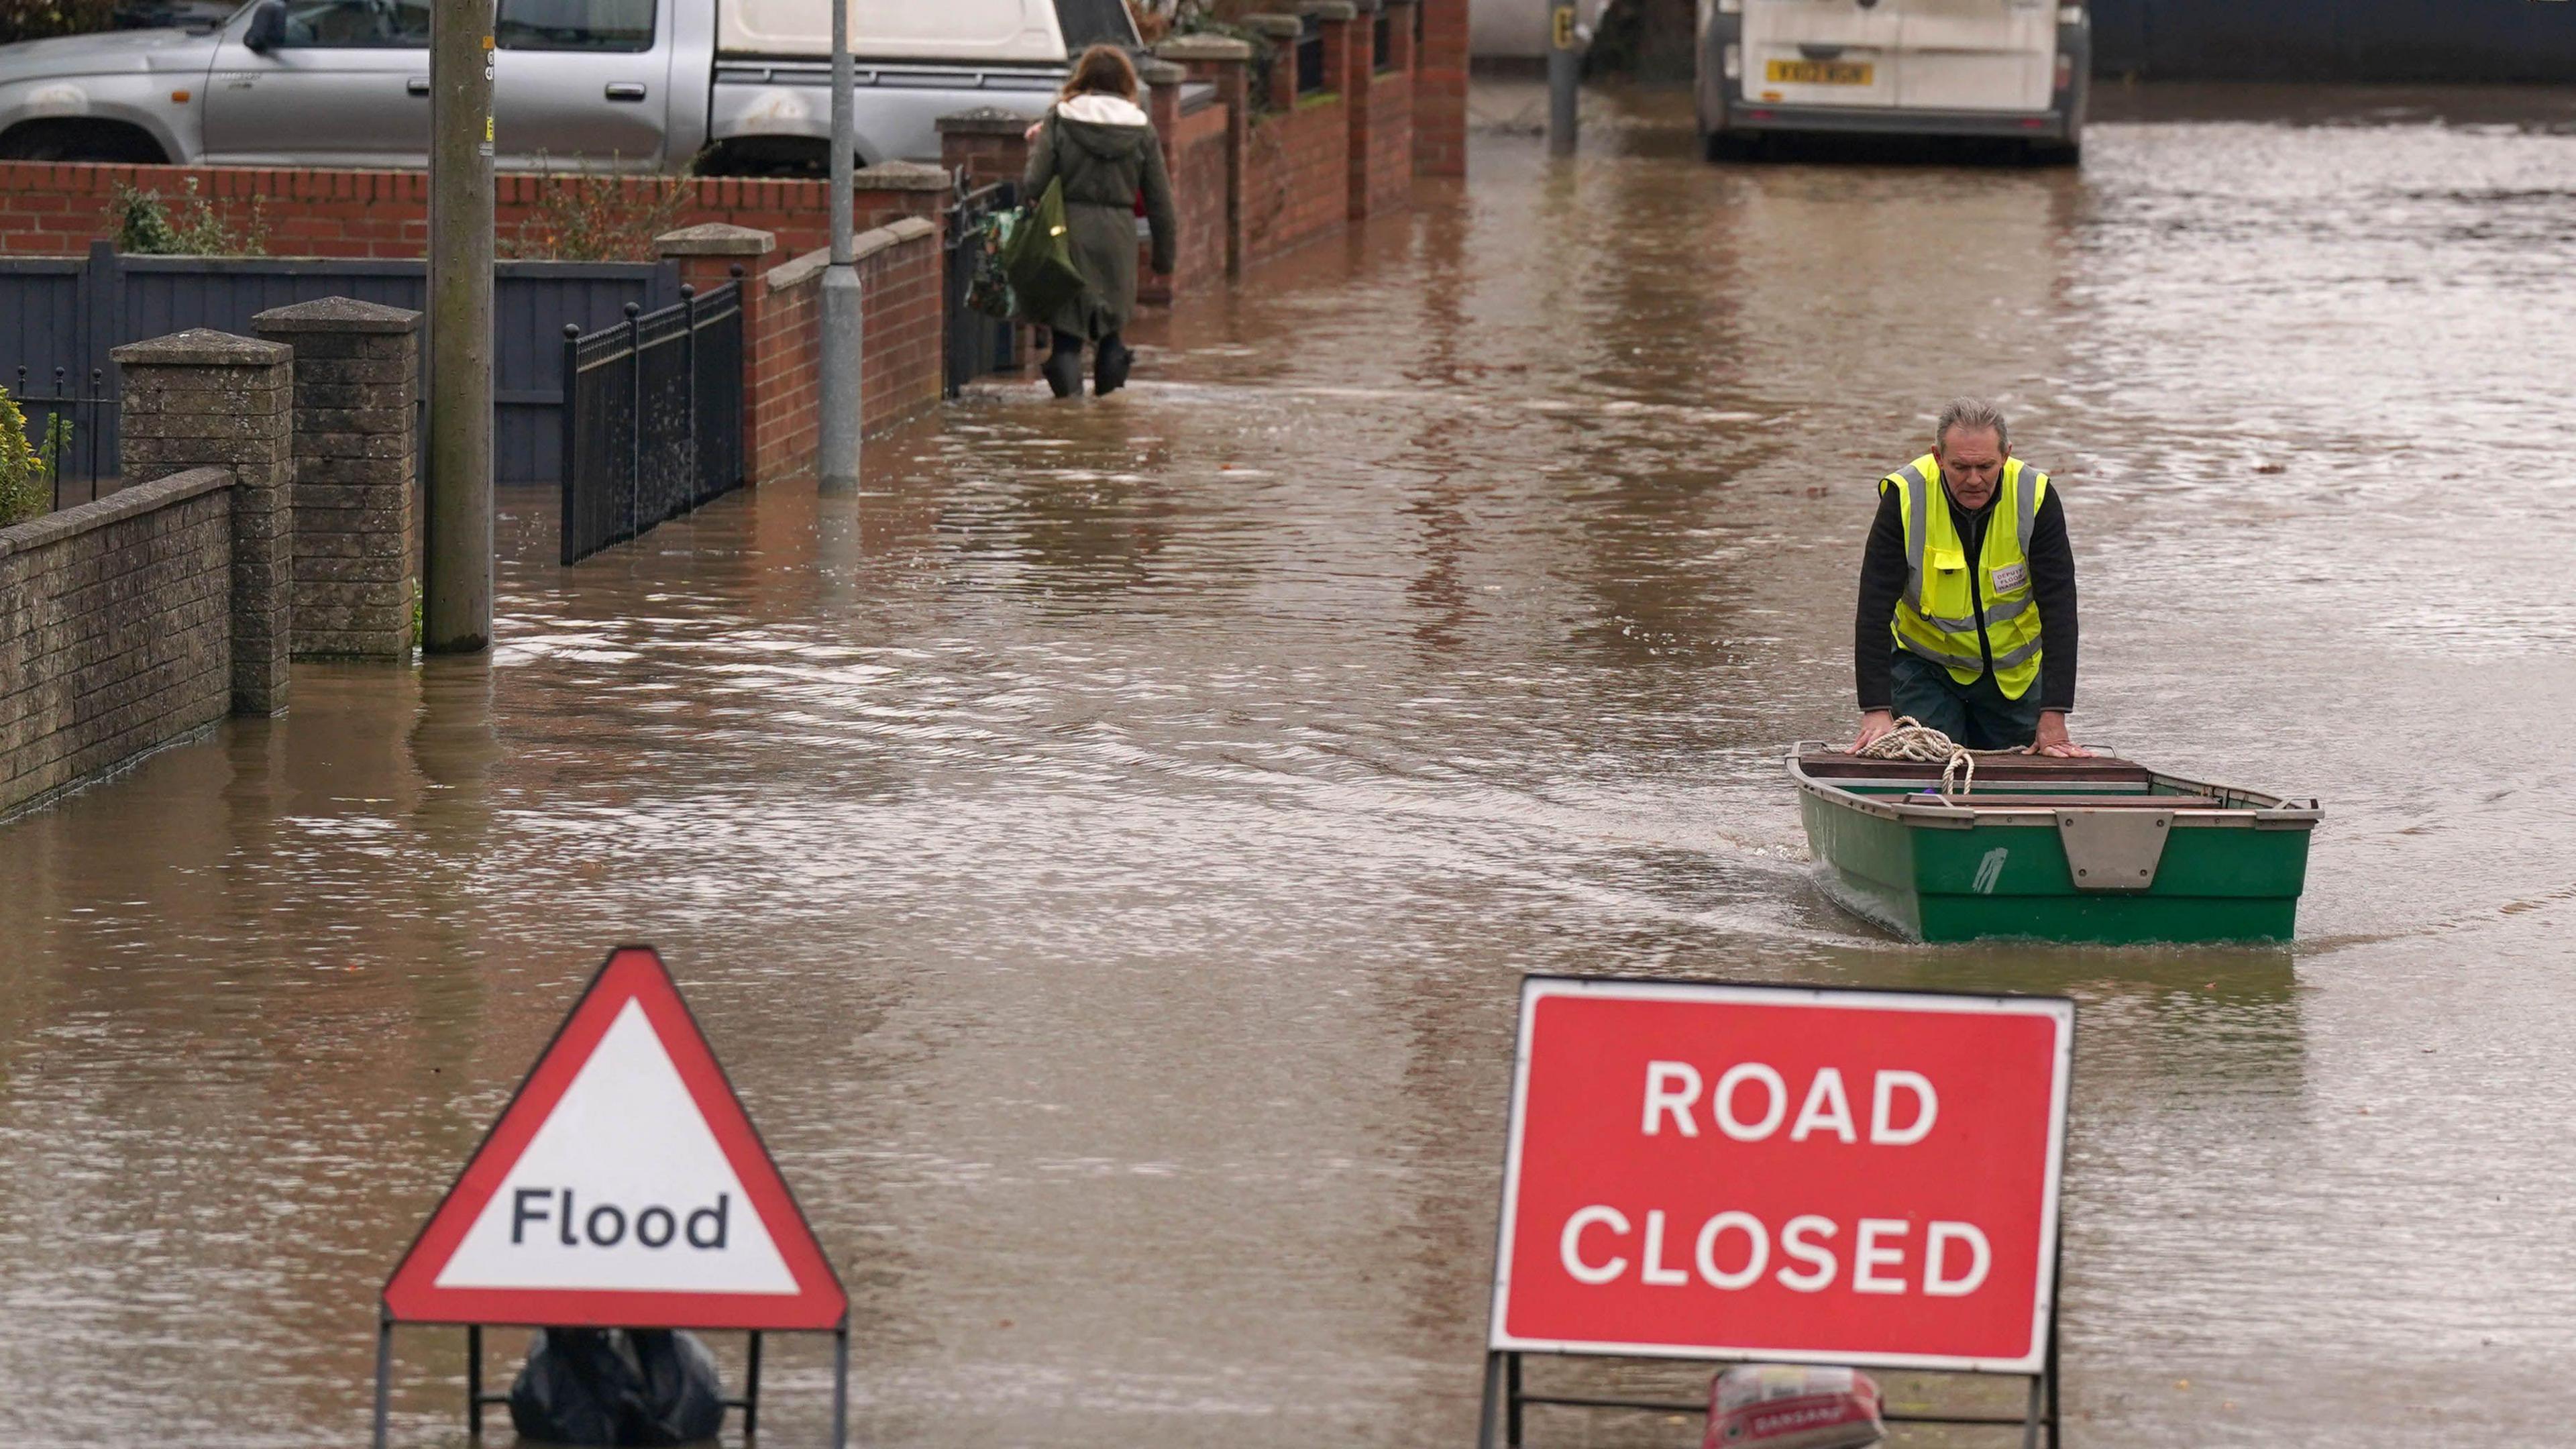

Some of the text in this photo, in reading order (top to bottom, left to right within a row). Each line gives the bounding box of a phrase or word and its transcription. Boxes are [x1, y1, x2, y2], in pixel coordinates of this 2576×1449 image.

[1997, 568, 2023, 580] DEPUTY
[2000, 574, 2023, 584] FLOOD
[1643, 1061, 1937, 1144] ROAD
[513, 1189, 727, 1248] Flood
[1561, 1205, 1990, 1295] CLOSED
